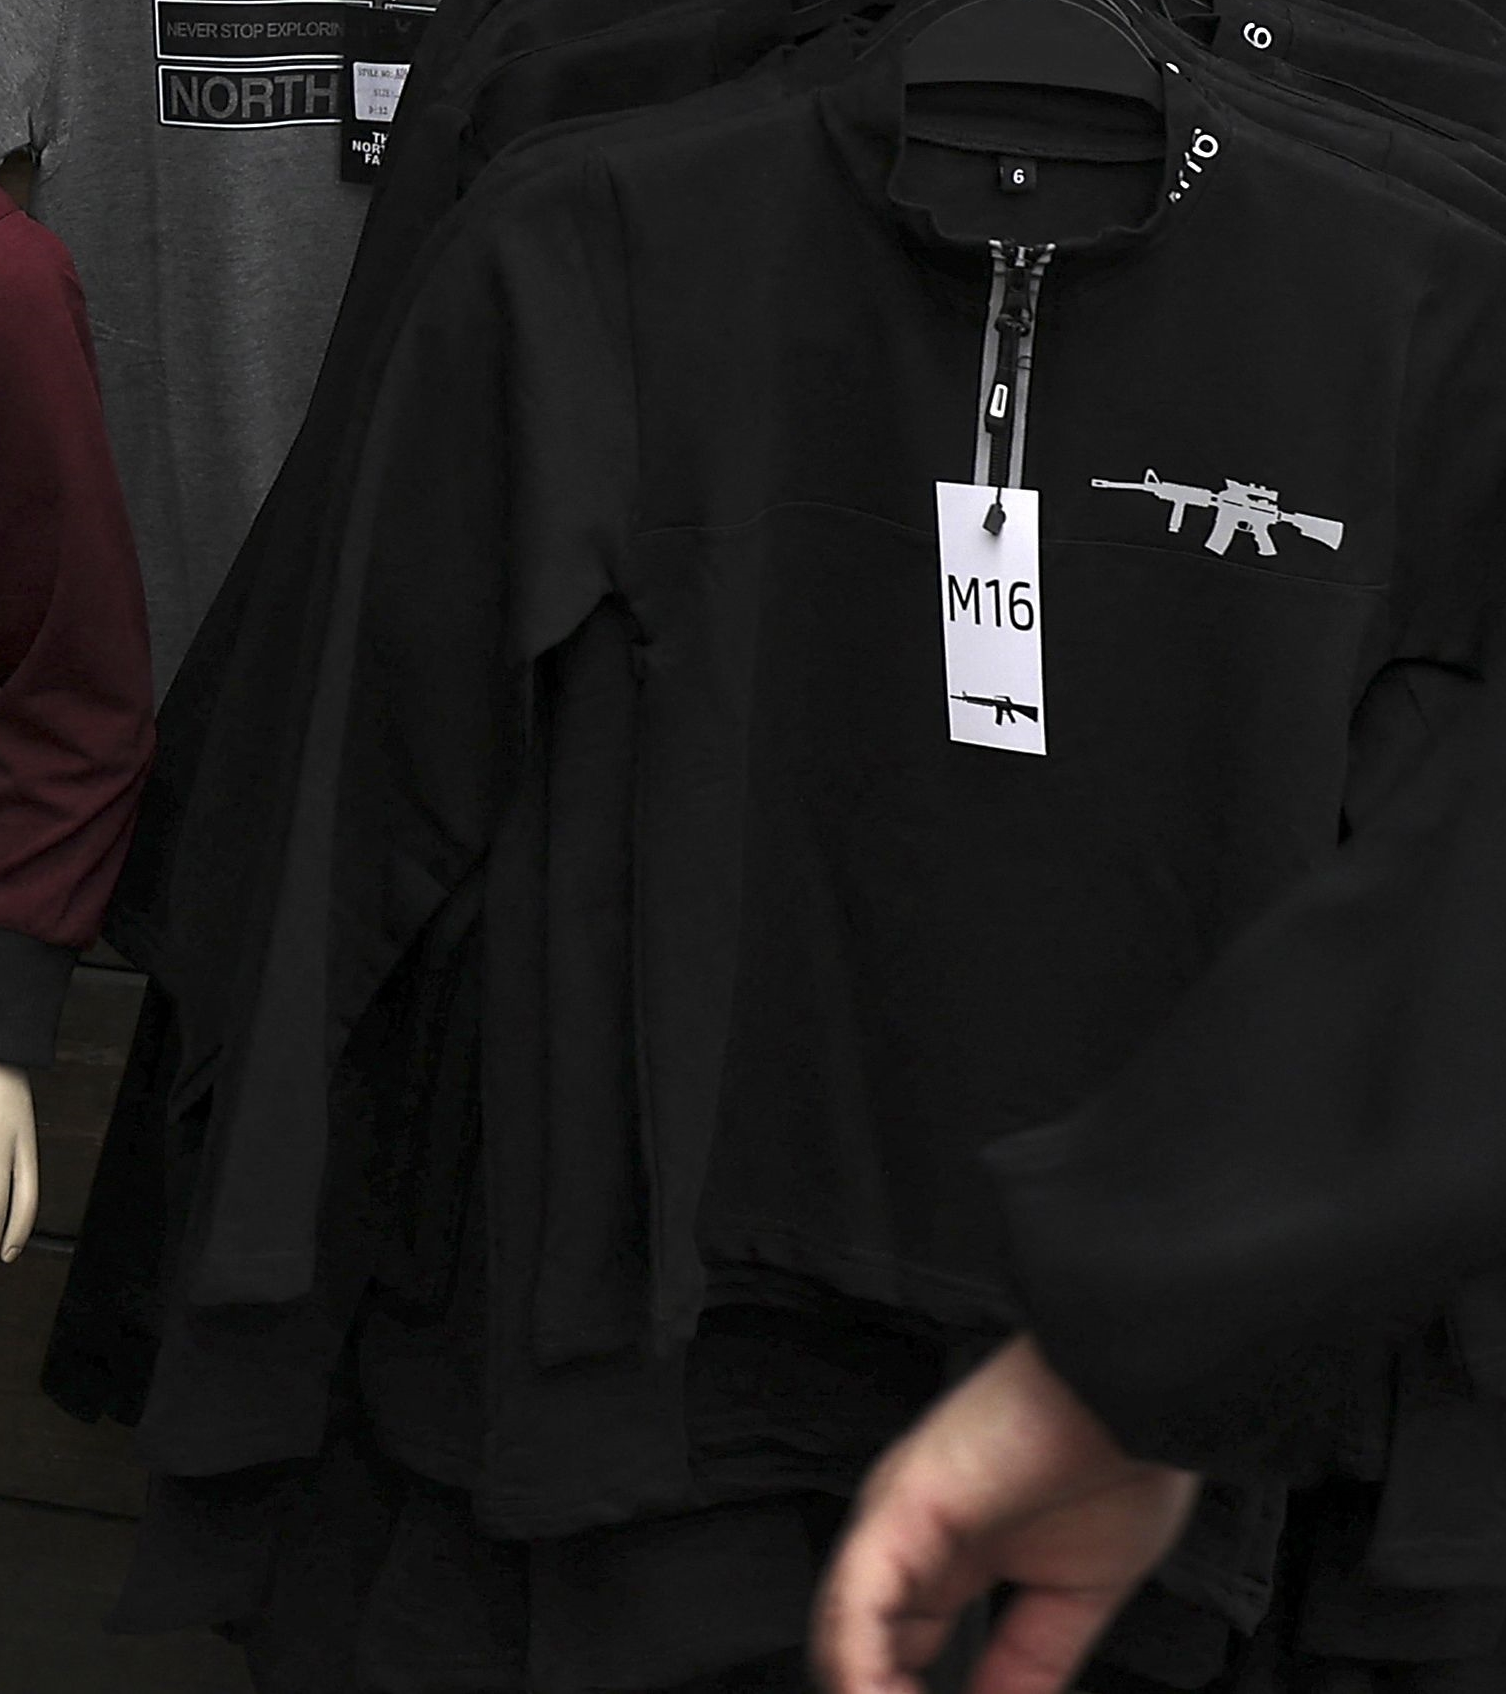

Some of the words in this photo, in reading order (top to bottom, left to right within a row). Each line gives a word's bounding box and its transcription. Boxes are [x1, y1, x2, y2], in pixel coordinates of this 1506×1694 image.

[166, 21, 219, 39] NEVER
[220, 22, 264, 39] STOP
[1243, 21, 1273, 50] 6
[169, 73, 337, 119] NORTH
[1013, 167, 1026, 185] 6
[948, 574, 1034, 631] M16
